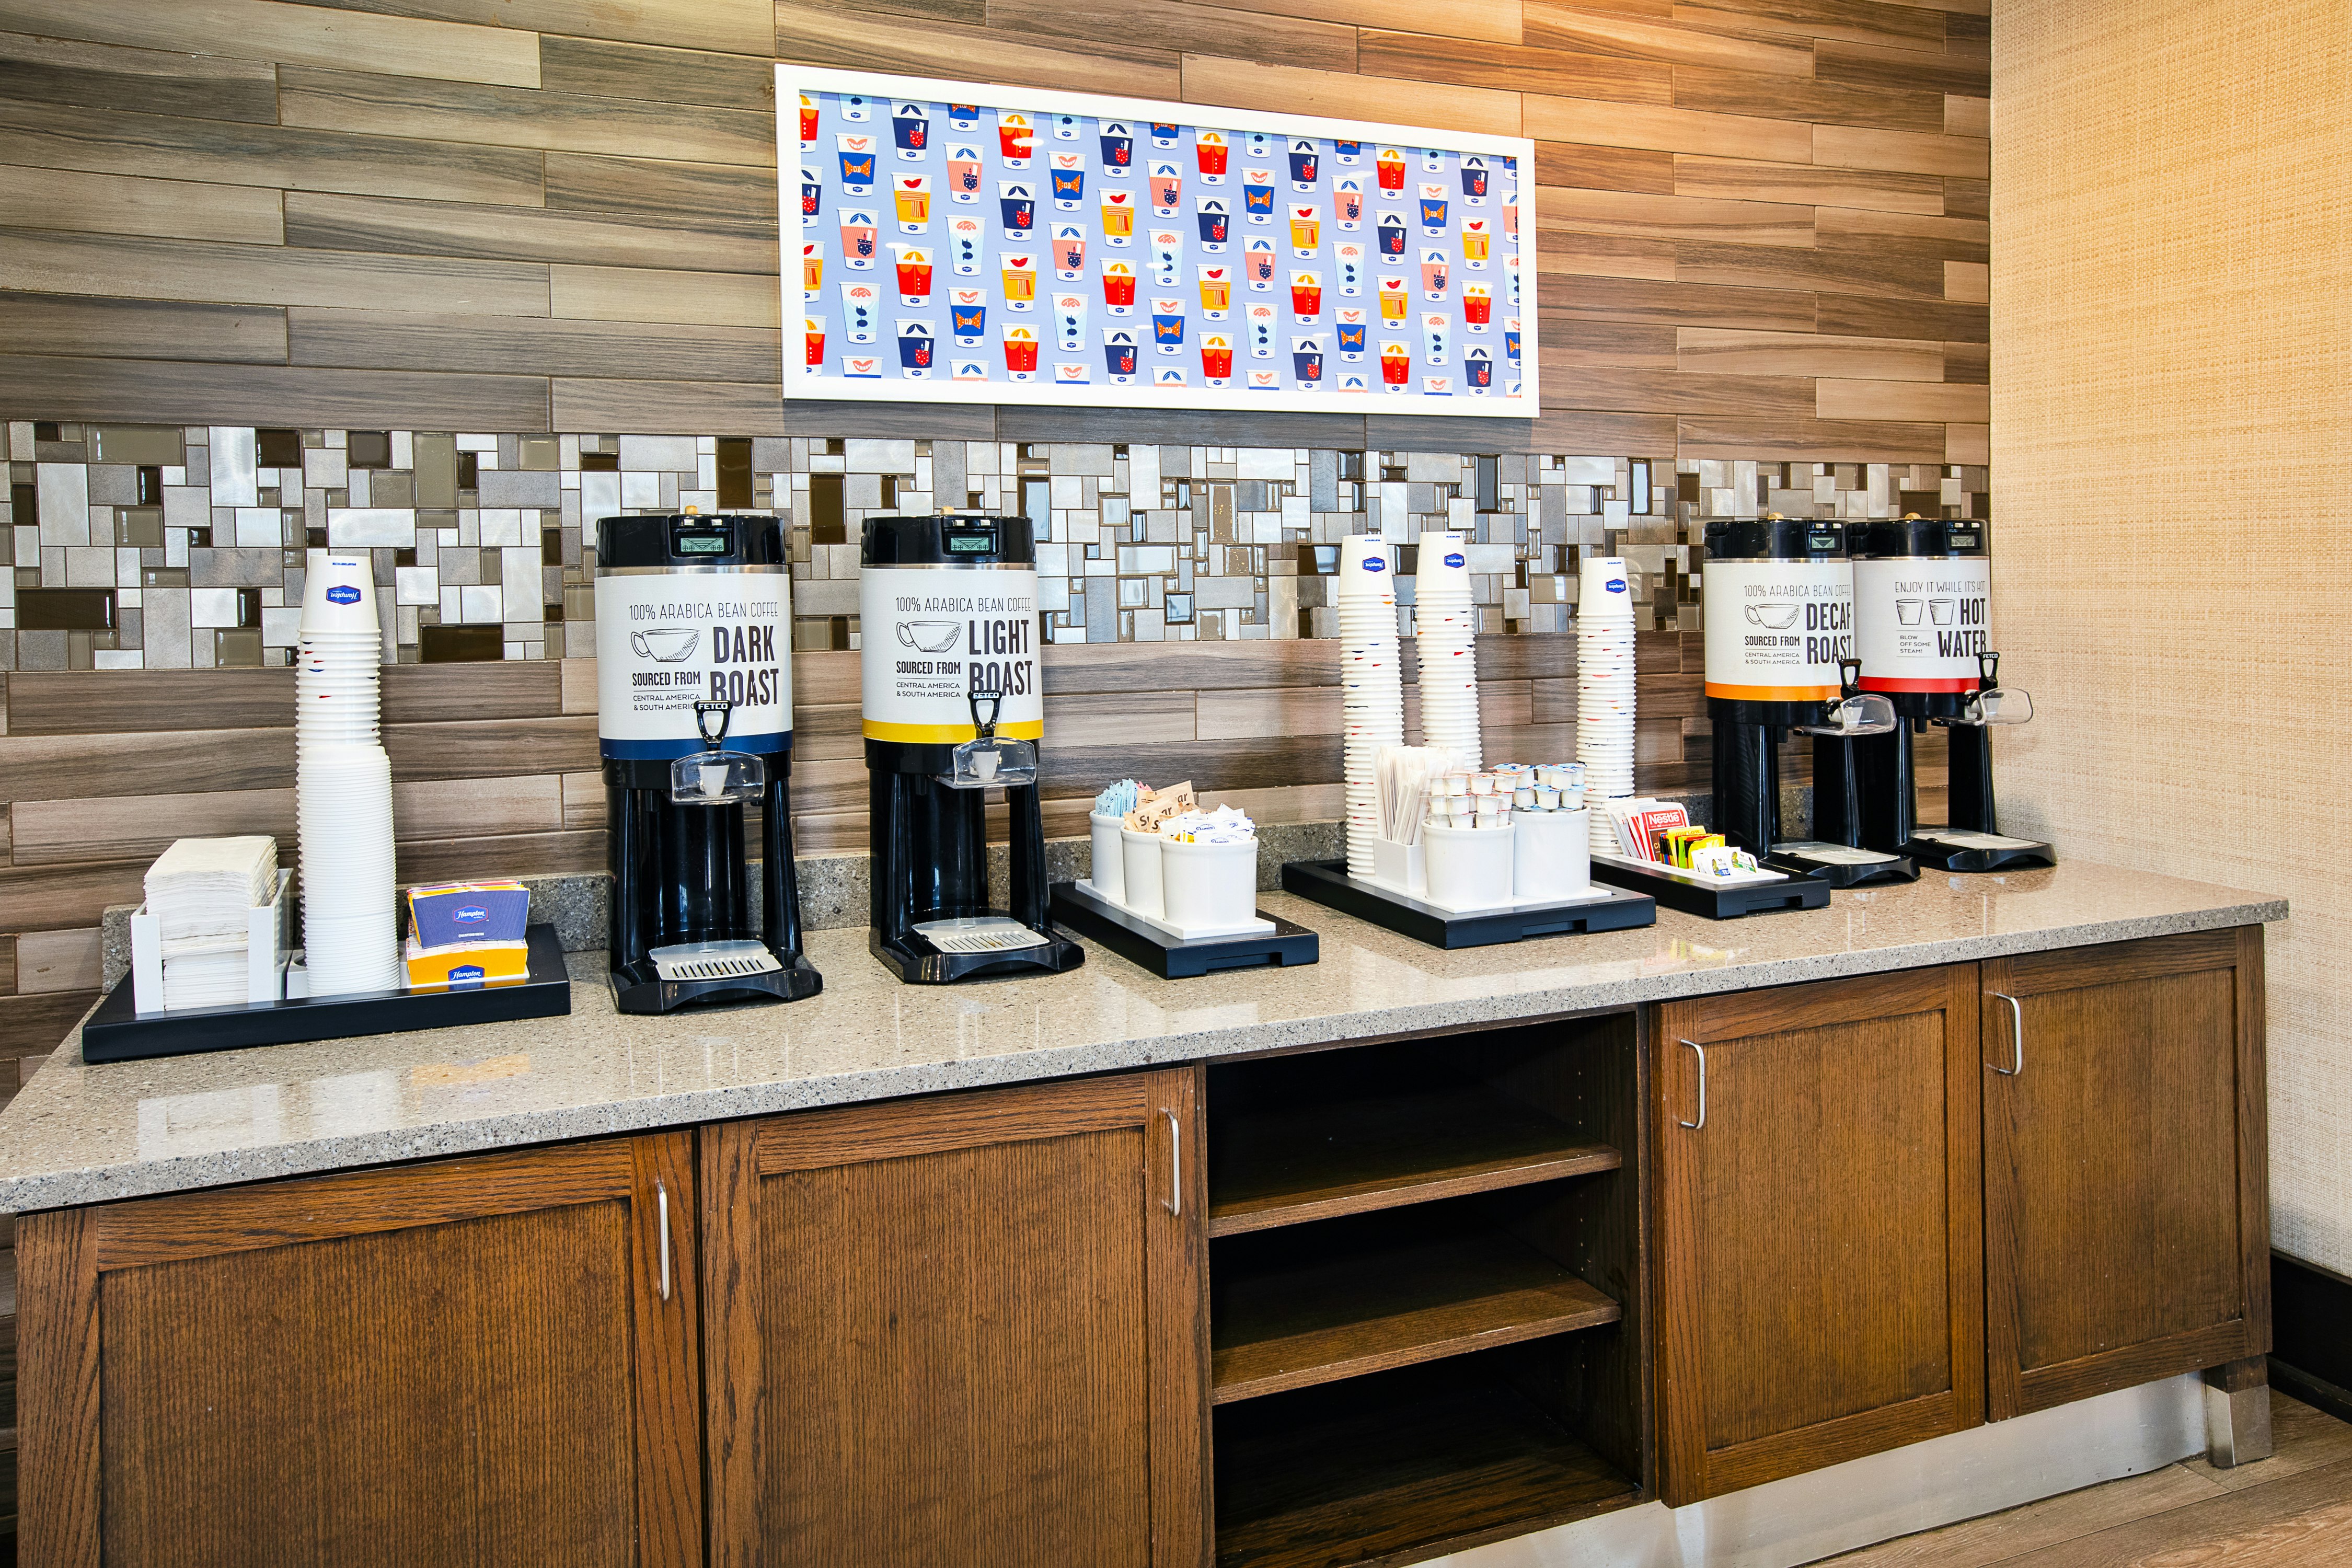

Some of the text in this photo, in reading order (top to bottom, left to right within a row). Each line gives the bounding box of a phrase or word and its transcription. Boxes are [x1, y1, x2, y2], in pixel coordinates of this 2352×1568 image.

[1744, 584, 1851, 597] 100% ARABICA BEAN COFFEE
[1895, 581, 1985, 593] ENJOY IT WHILE IT'S HOT
[629, 602, 778, 620] 100% ARABICA BEAN COFFEE
[896, 597, 1031, 612] 100% ARABICA BEAN COFFEE
[1961, 598, 1985, 625] HOT
[1807, 602, 1850, 631] DECAF
[713, 625, 775, 663] DARK
[969, 619, 1029, 655] LIGHT
[1745, 635, 1800, 647] SOURCED FROM
[1938, 630, 1986, 658] WATER
[1807, 635, 1851, 664] ROAST
[896, 661, 961, 674] SOURCED FROM
[632, 671, 700, 686] SOURCED FROM
[710, 668, 779, 707] ROAST
[969, 661, 1032, 696] ROAST
[456, 910, 485, 919] Hampton
[451, 971, 481, 980] Hampton
